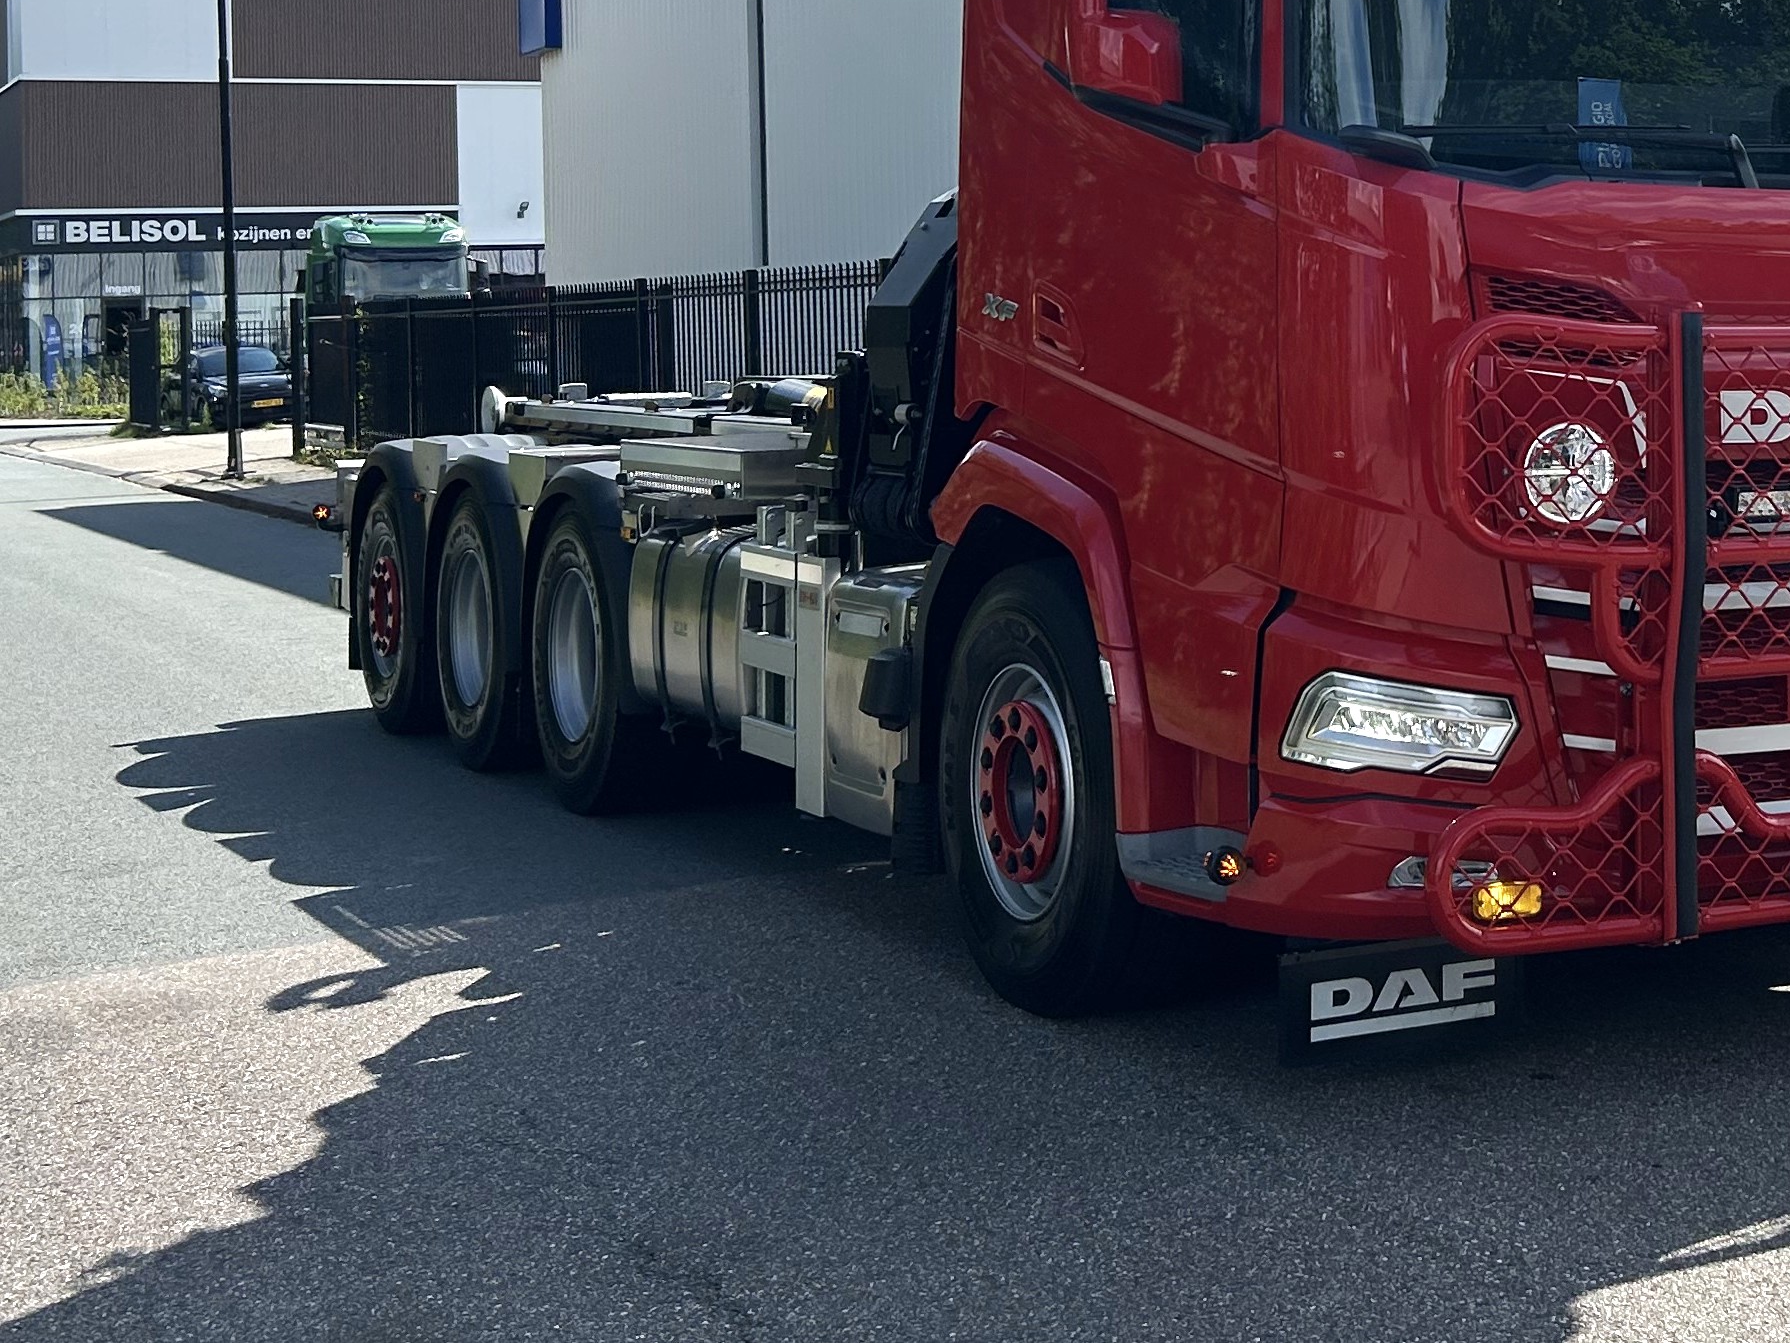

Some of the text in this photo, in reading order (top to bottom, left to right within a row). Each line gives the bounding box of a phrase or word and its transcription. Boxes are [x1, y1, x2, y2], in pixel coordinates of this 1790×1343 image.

[1590, 101, 1612, 168] PIGIO
[65, 219, 207, 243] BELISOL
[104, 284, 141, 295] Ingang
[981, 292, 1020, 322] XF
[1310, 957, 1496, 1022] DAF
